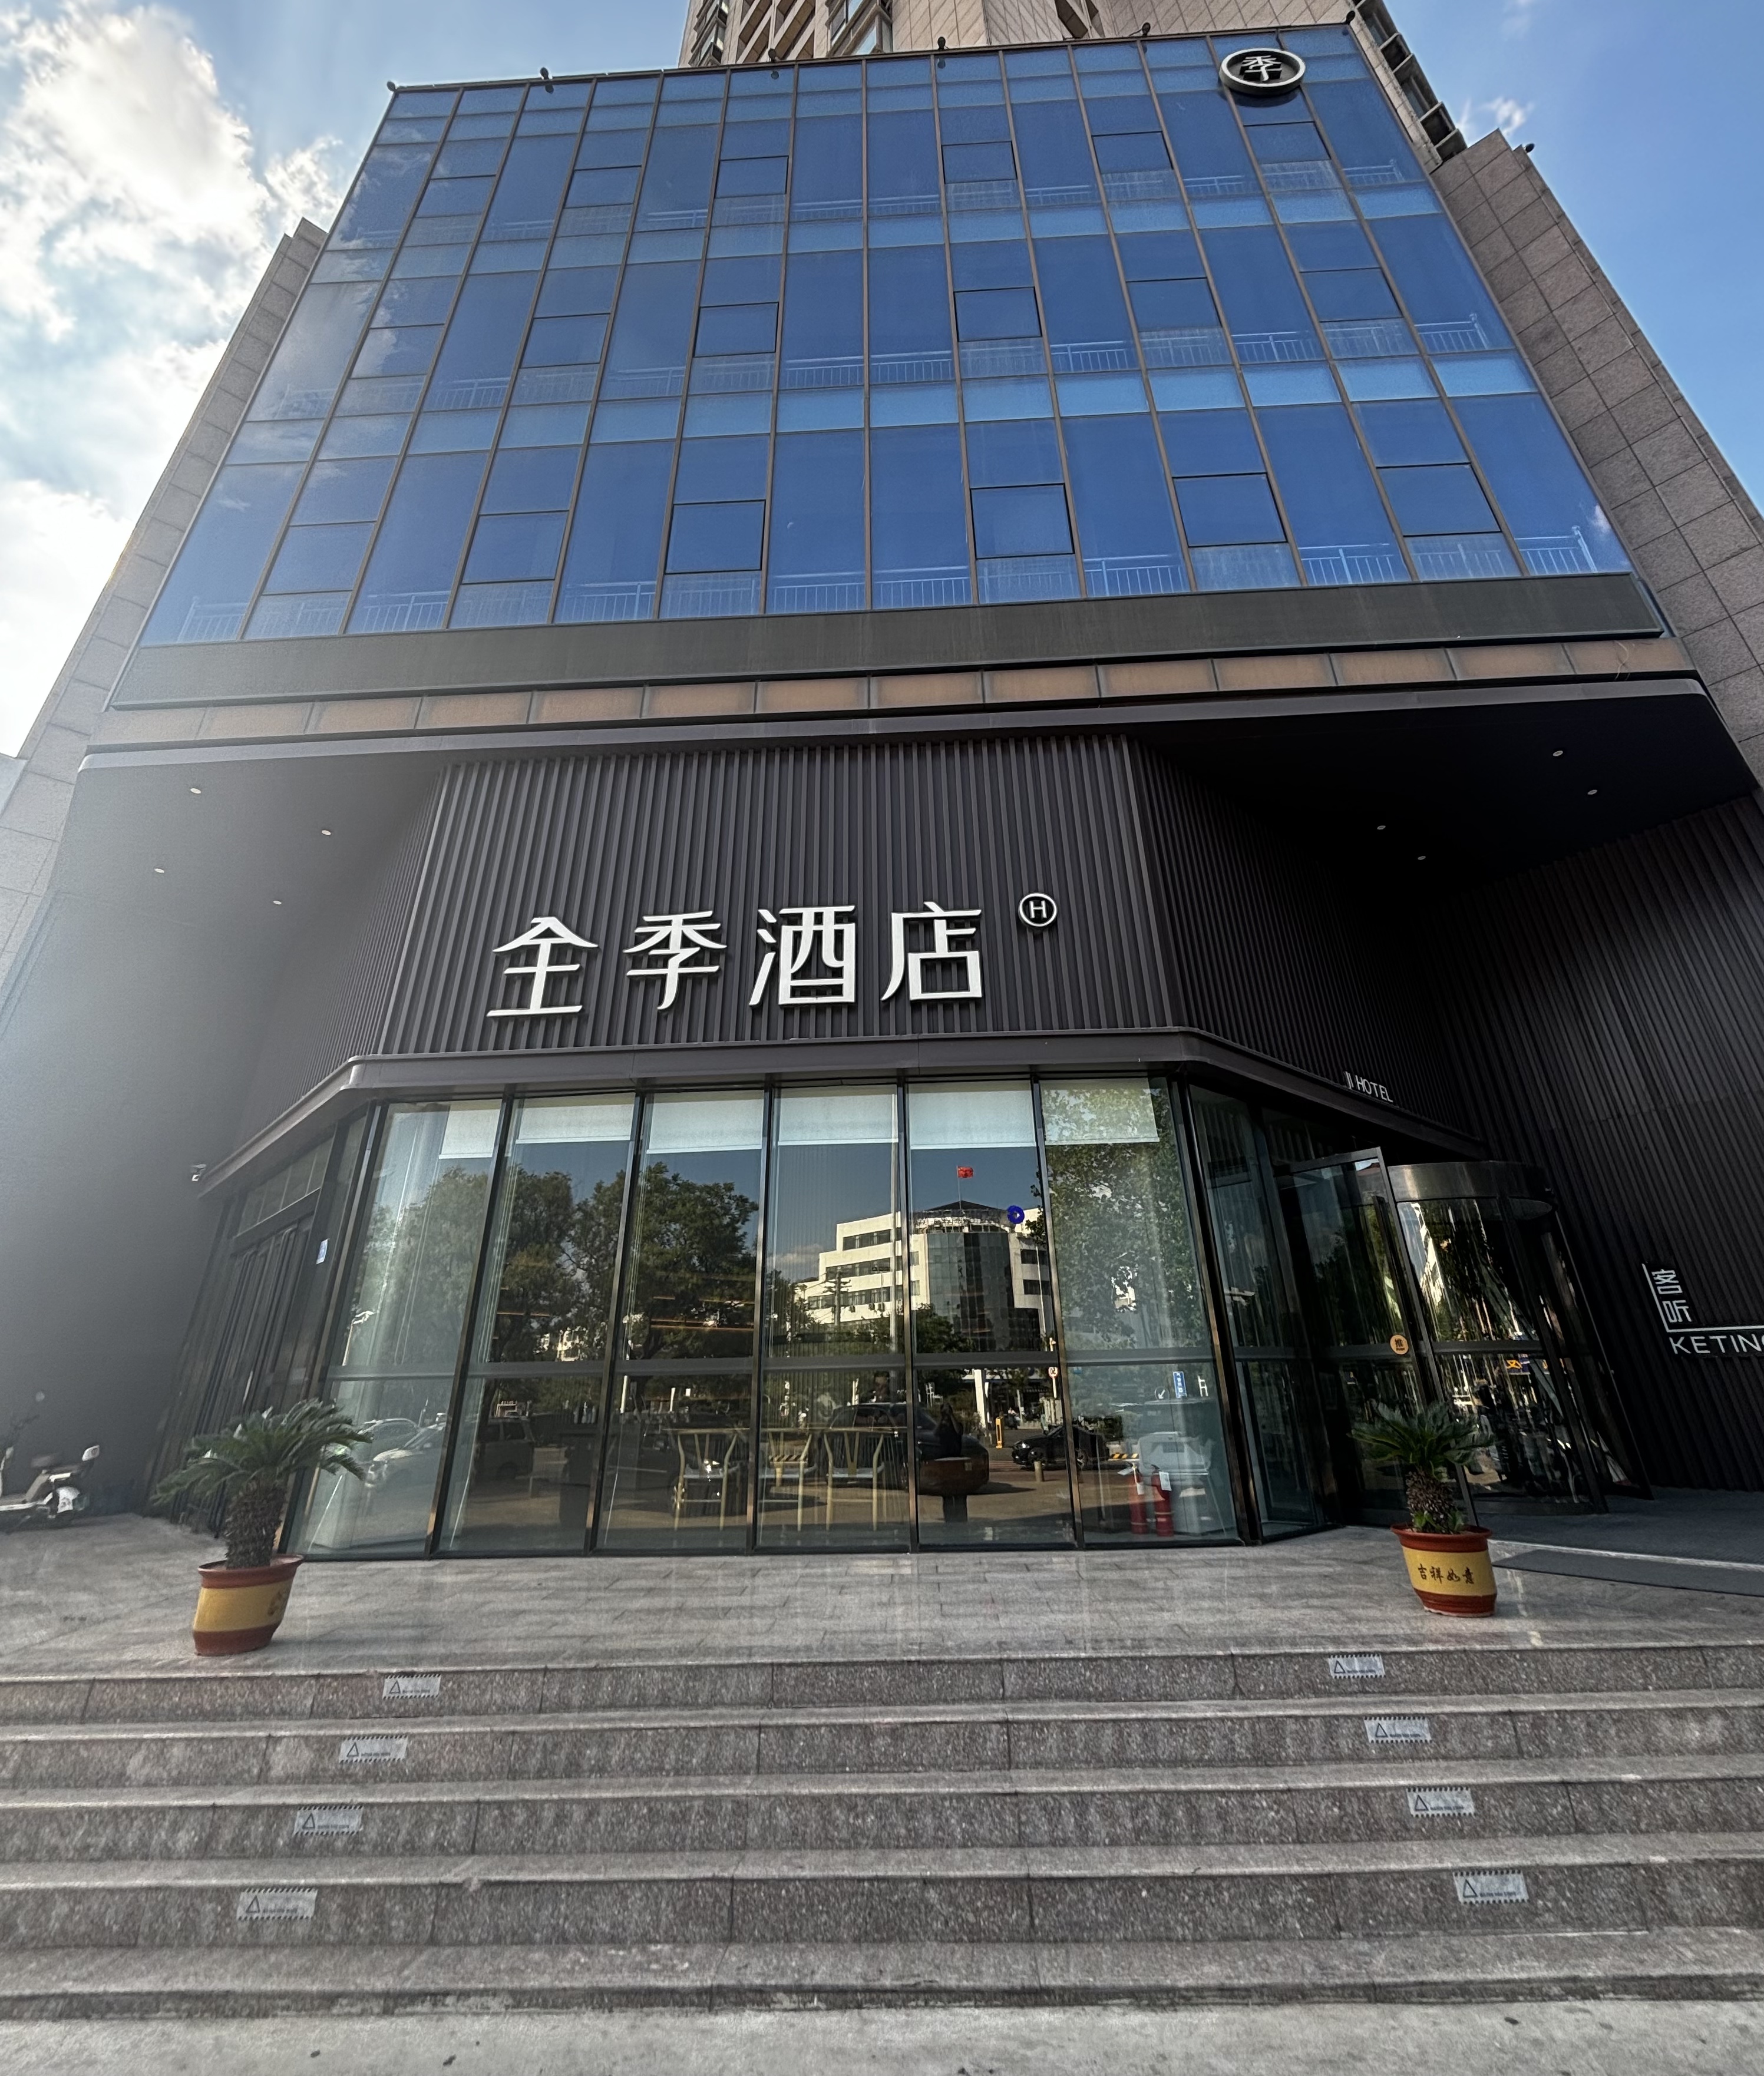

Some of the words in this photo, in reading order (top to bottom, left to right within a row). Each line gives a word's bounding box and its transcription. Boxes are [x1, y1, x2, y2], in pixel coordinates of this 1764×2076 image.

[1241, 55, 1282, 81] 季
[487, 901, 982, 1018] 全季酒店
[1355, 1075, 1393, 1103] HOTEL
[1669, 1333, 1764, 1354] KETIN
[1418, 1563, 1474, 1584] 吉祥如意
